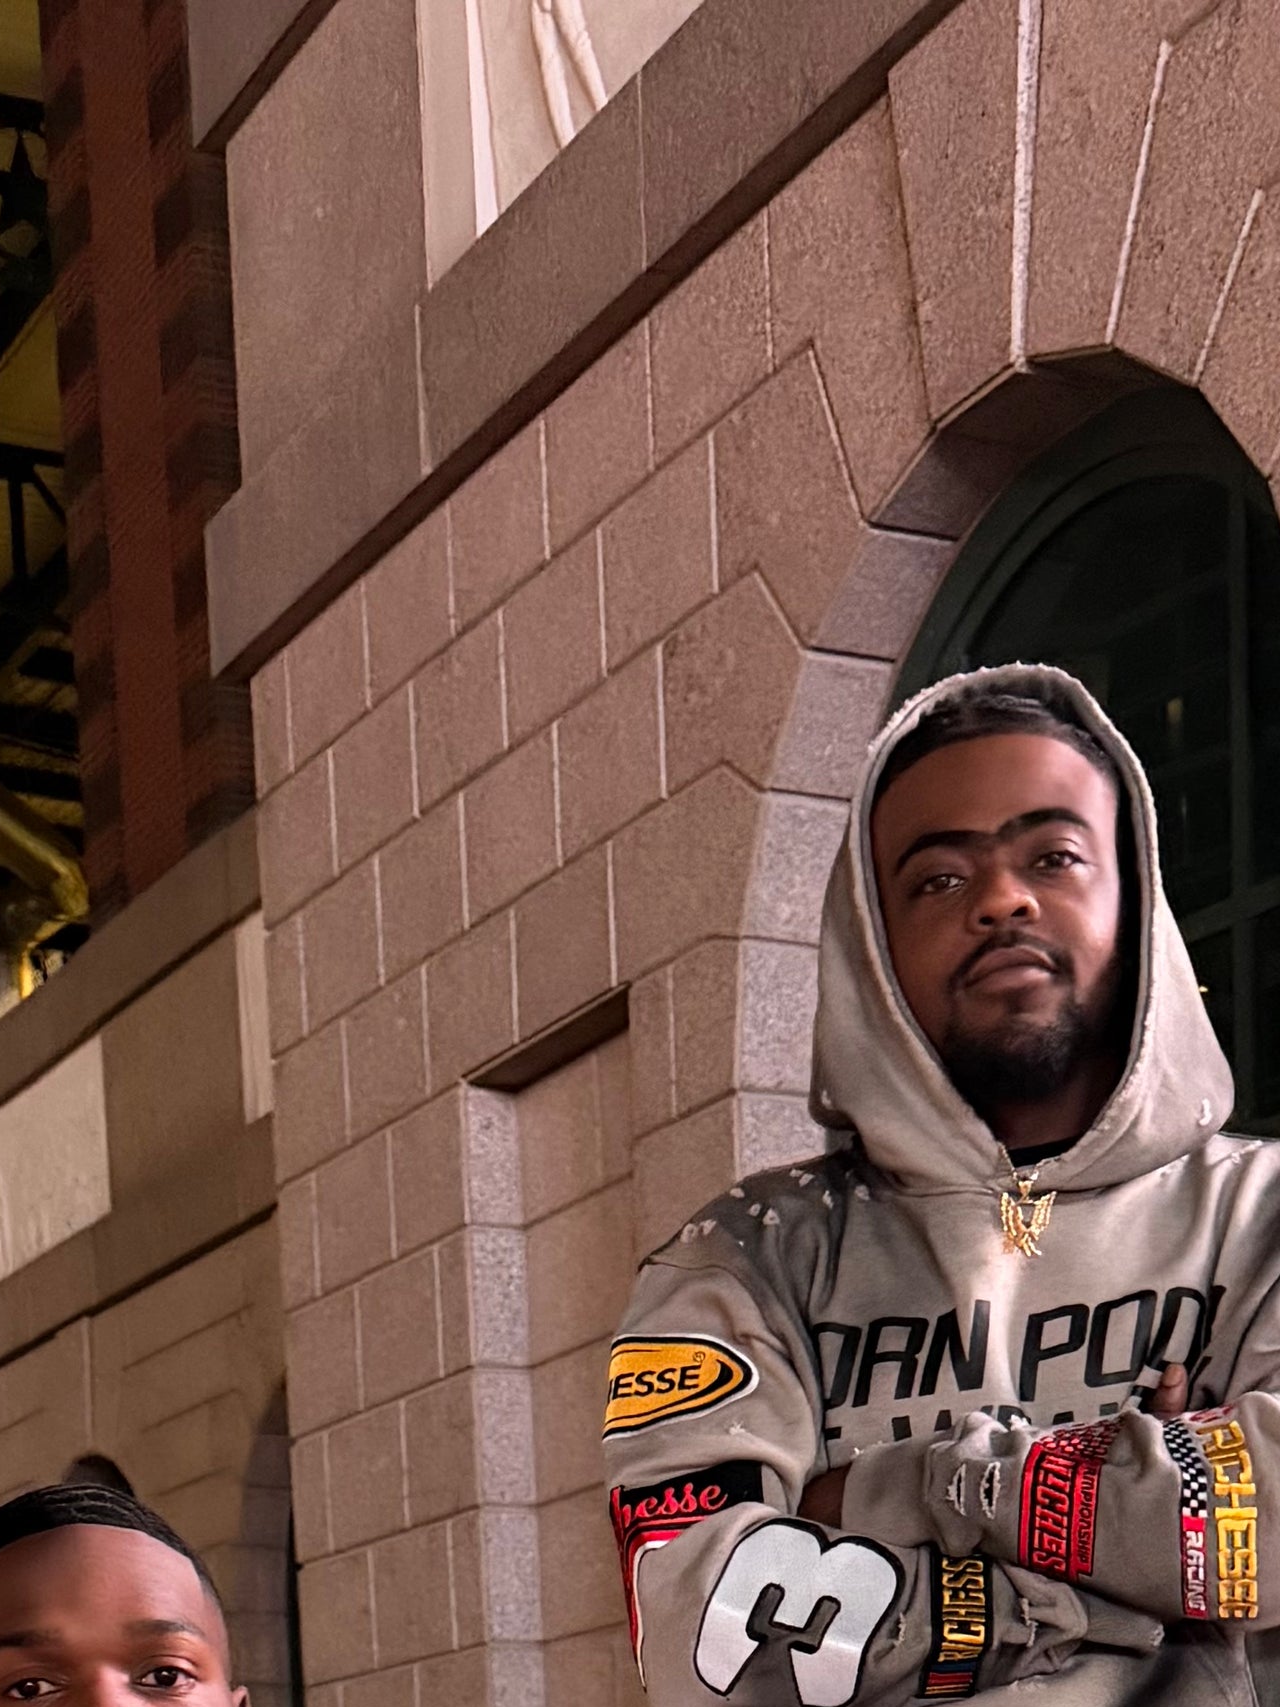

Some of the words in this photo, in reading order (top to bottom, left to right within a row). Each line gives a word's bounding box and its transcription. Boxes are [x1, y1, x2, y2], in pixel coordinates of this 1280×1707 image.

[608, 1364, 702, 1402] ESSE
[812, 1298, 991, 1408] ORN
[1019, 1286, 1227, 1402] POO
[936, 1556, 987, 1663] RICHESS
[1185, 1529, 1208, 1612] RACING
